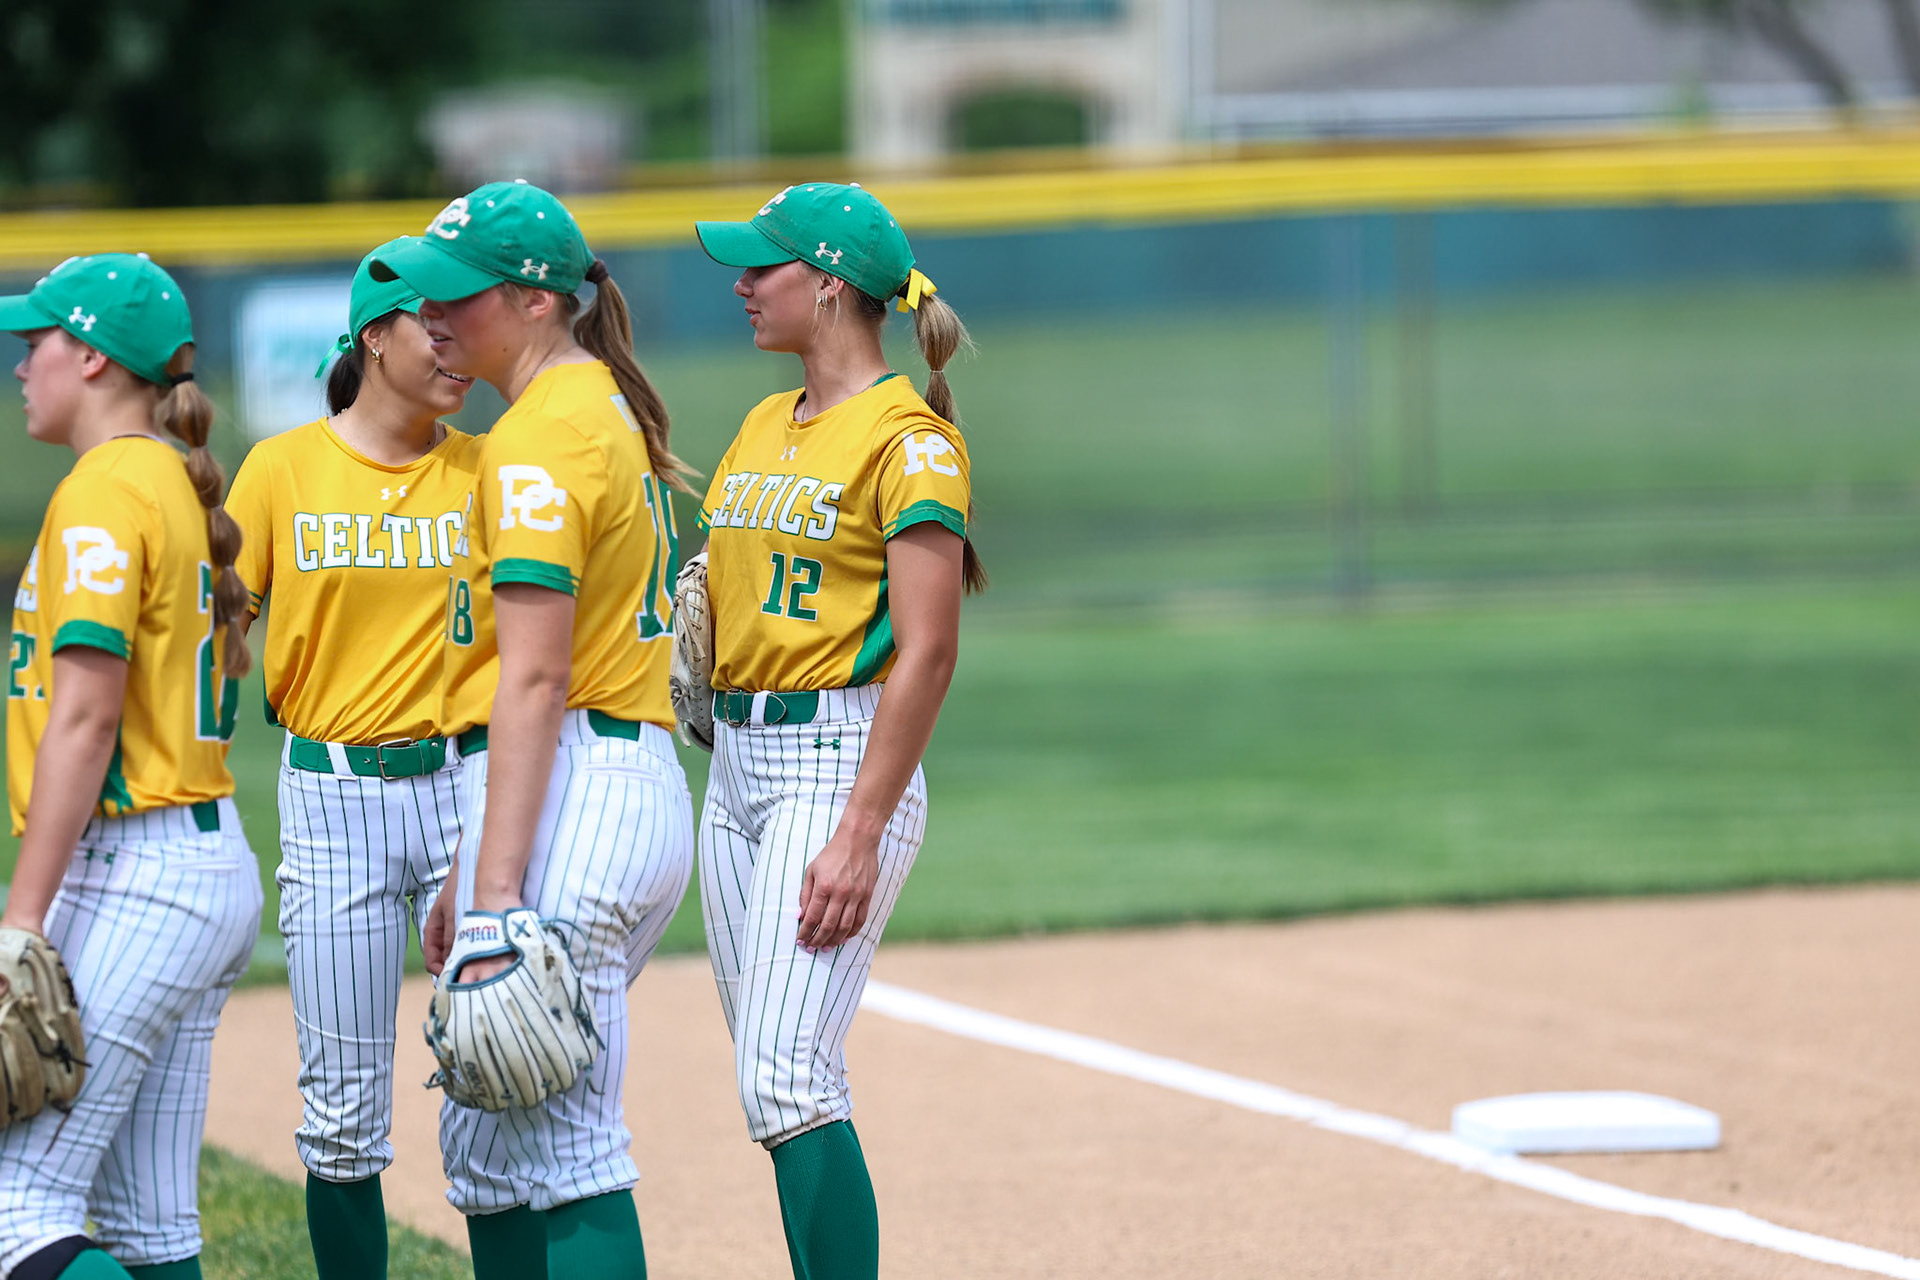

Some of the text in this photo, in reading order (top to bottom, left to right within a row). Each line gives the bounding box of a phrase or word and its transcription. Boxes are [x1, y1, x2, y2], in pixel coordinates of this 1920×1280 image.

[498, 464, 567, 533] PC
[62, 526, 130, 596] PC
[760, 551, 824, 622] 12
